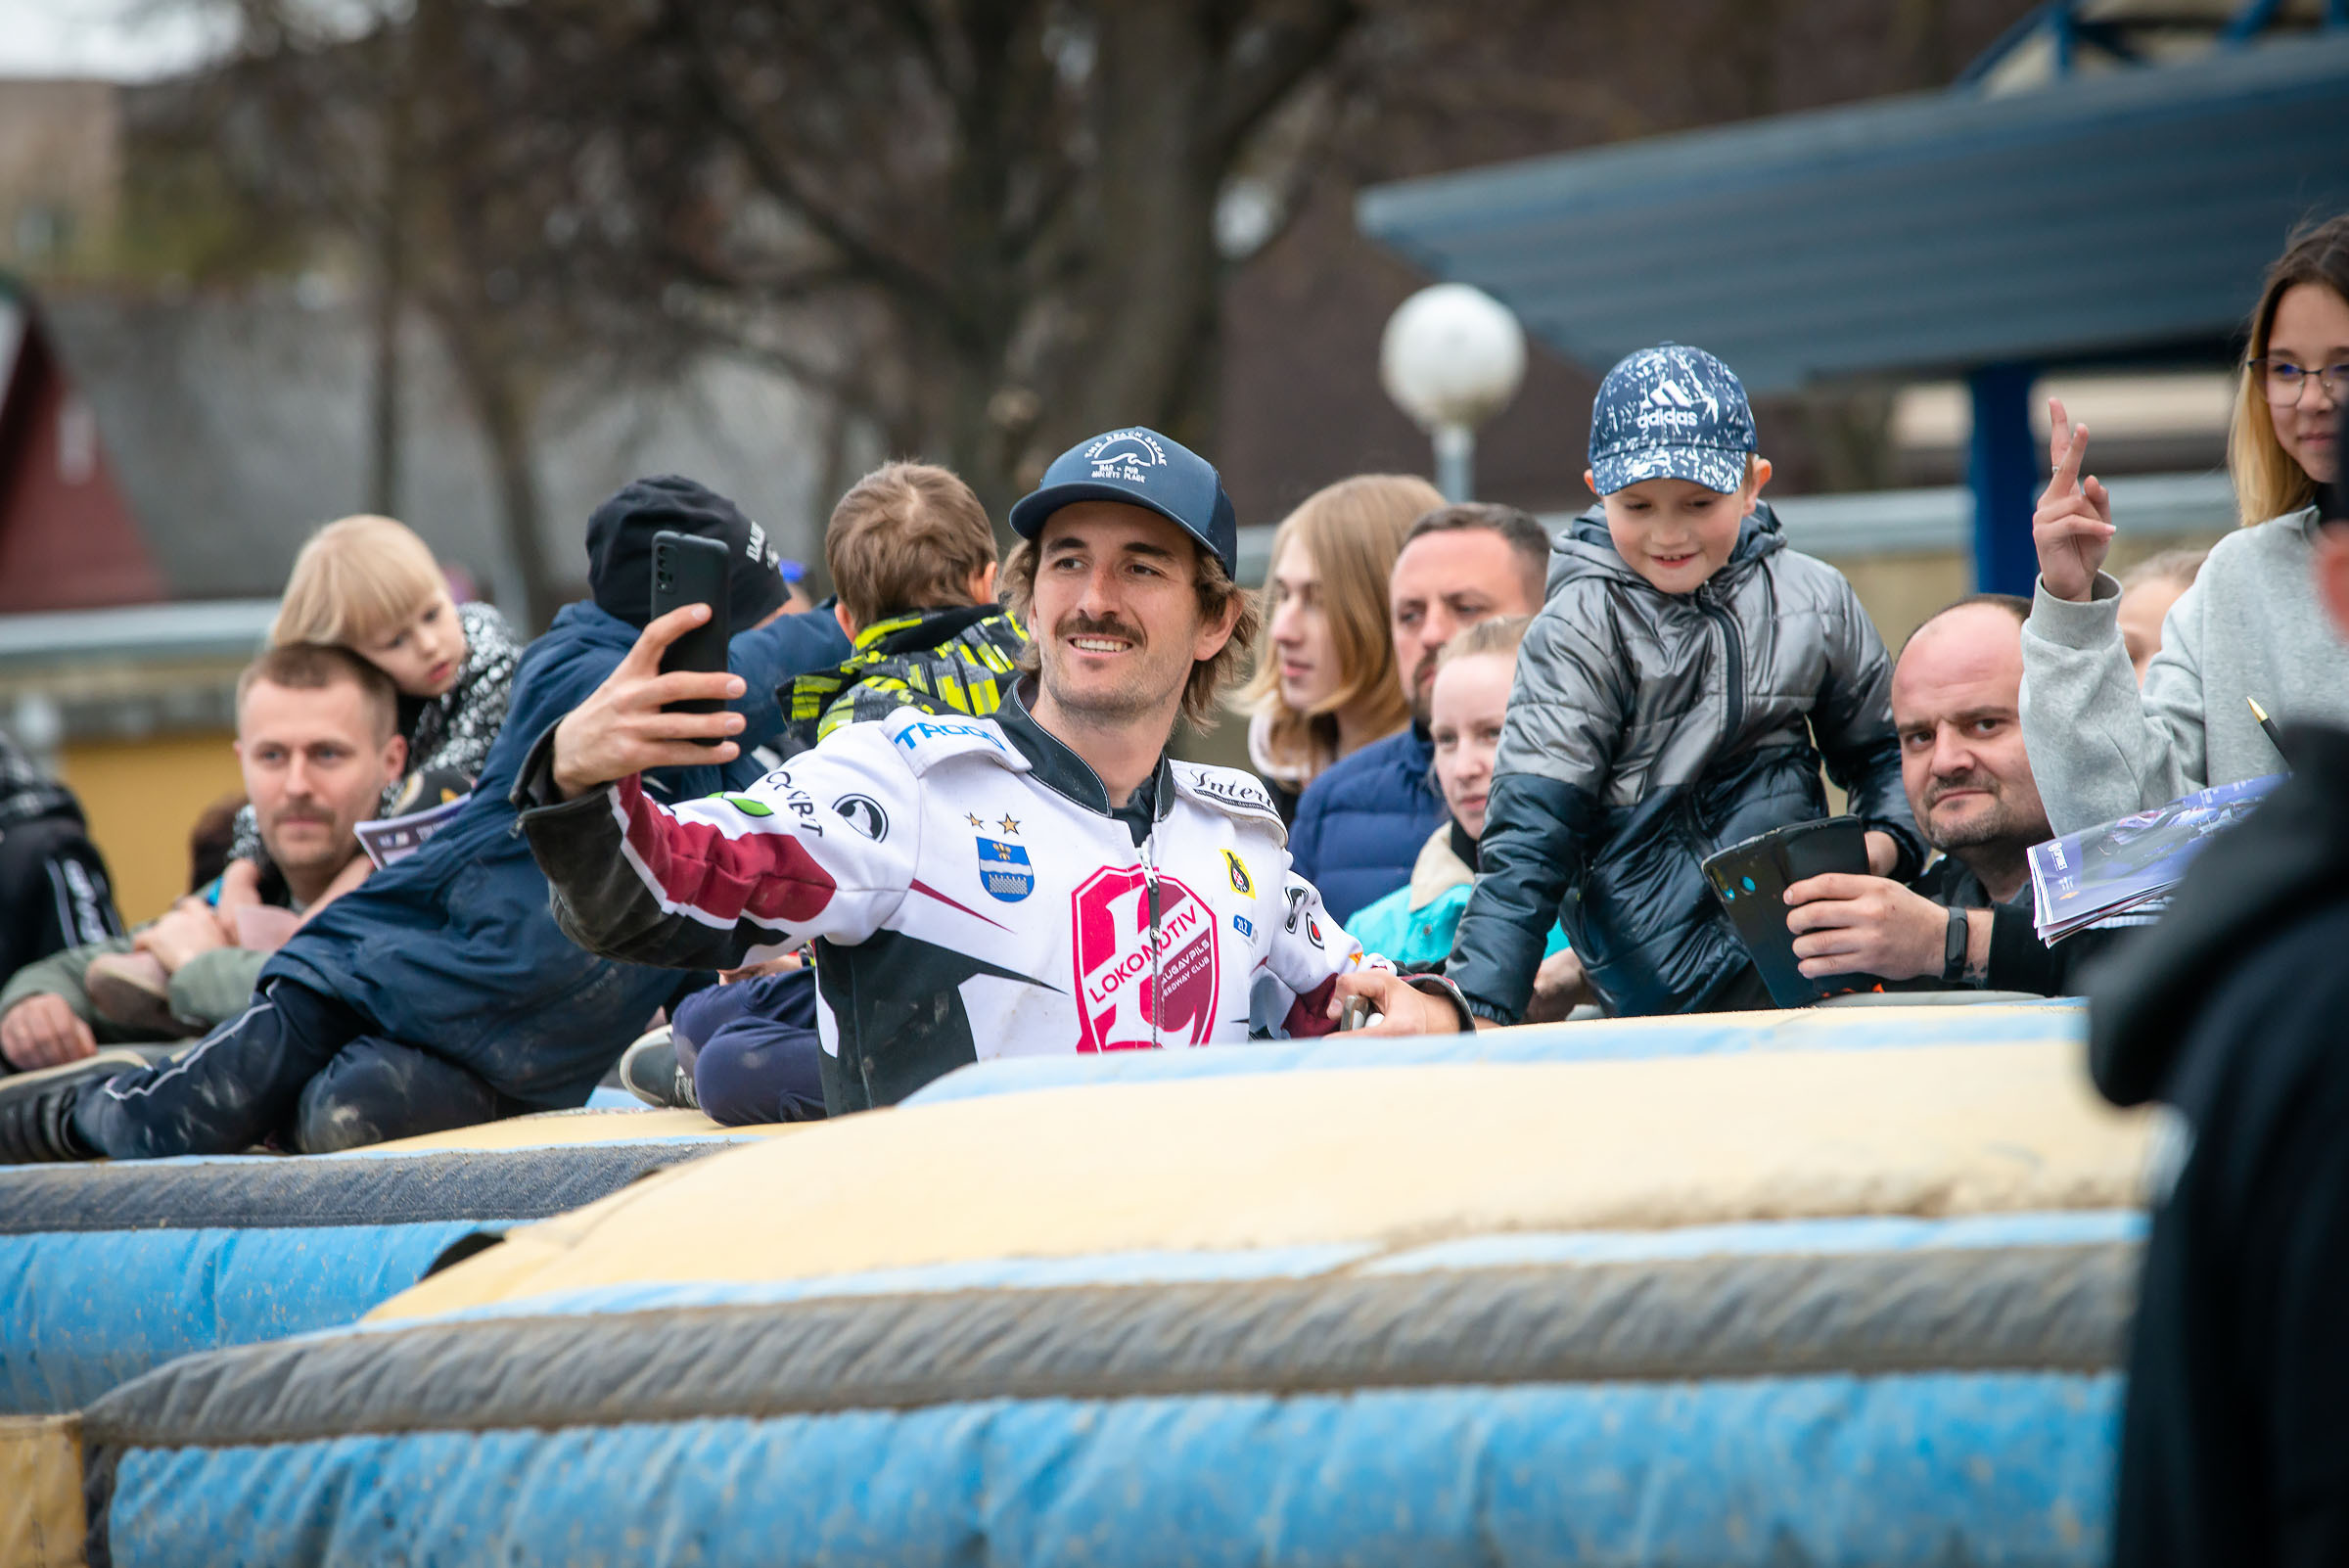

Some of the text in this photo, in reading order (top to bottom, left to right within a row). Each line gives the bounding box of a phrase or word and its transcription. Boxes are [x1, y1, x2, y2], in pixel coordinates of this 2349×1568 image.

[1636, 407, 1698, 429] adidas
[1084, 441, 1102, 458] THE
[1106, 431, 1143, 441] BEACH
[1191, 956, 1210, 974] CLUB
